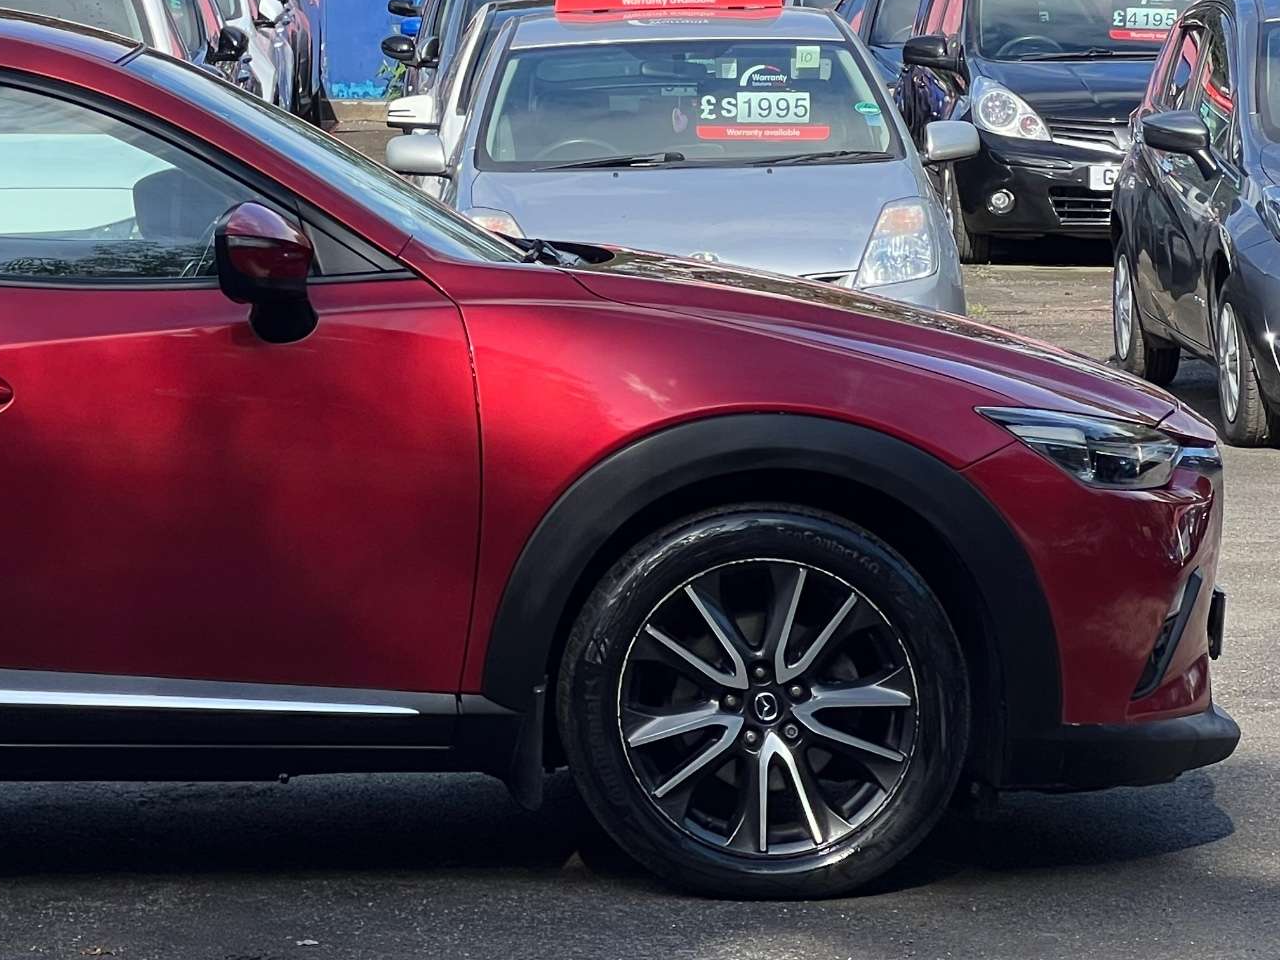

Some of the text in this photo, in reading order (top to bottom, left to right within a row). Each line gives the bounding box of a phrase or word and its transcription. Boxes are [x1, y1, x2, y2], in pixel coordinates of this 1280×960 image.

[752, 73, 787, 83] Warranty
[726, 128, 801, 137] Warranty available
